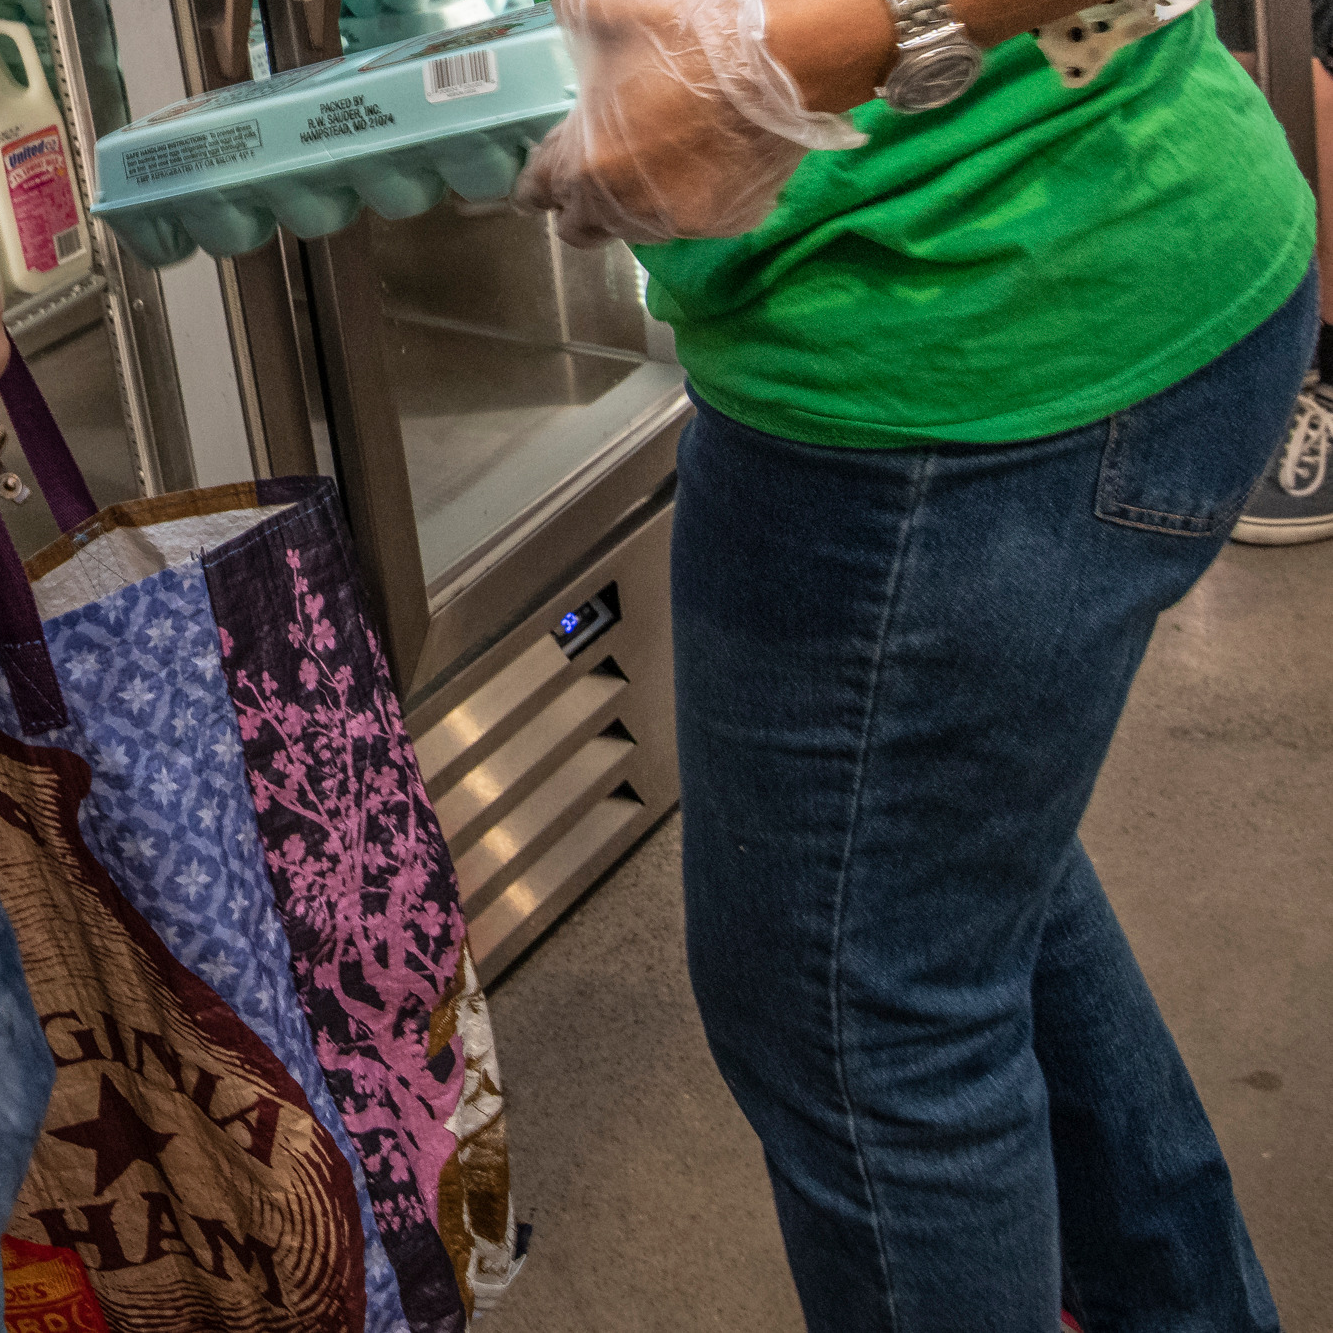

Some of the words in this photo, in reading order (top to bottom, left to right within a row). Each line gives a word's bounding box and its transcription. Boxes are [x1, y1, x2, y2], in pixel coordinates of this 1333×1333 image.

[319, 97, 352, 114] PACKED
[352, 94, 365, 106] BY
[327, 108, 364, 125] SAUDER,
[299, 122, 354, 144] HAMPSTEAD,
[368, 112, 395, 129] 21074
